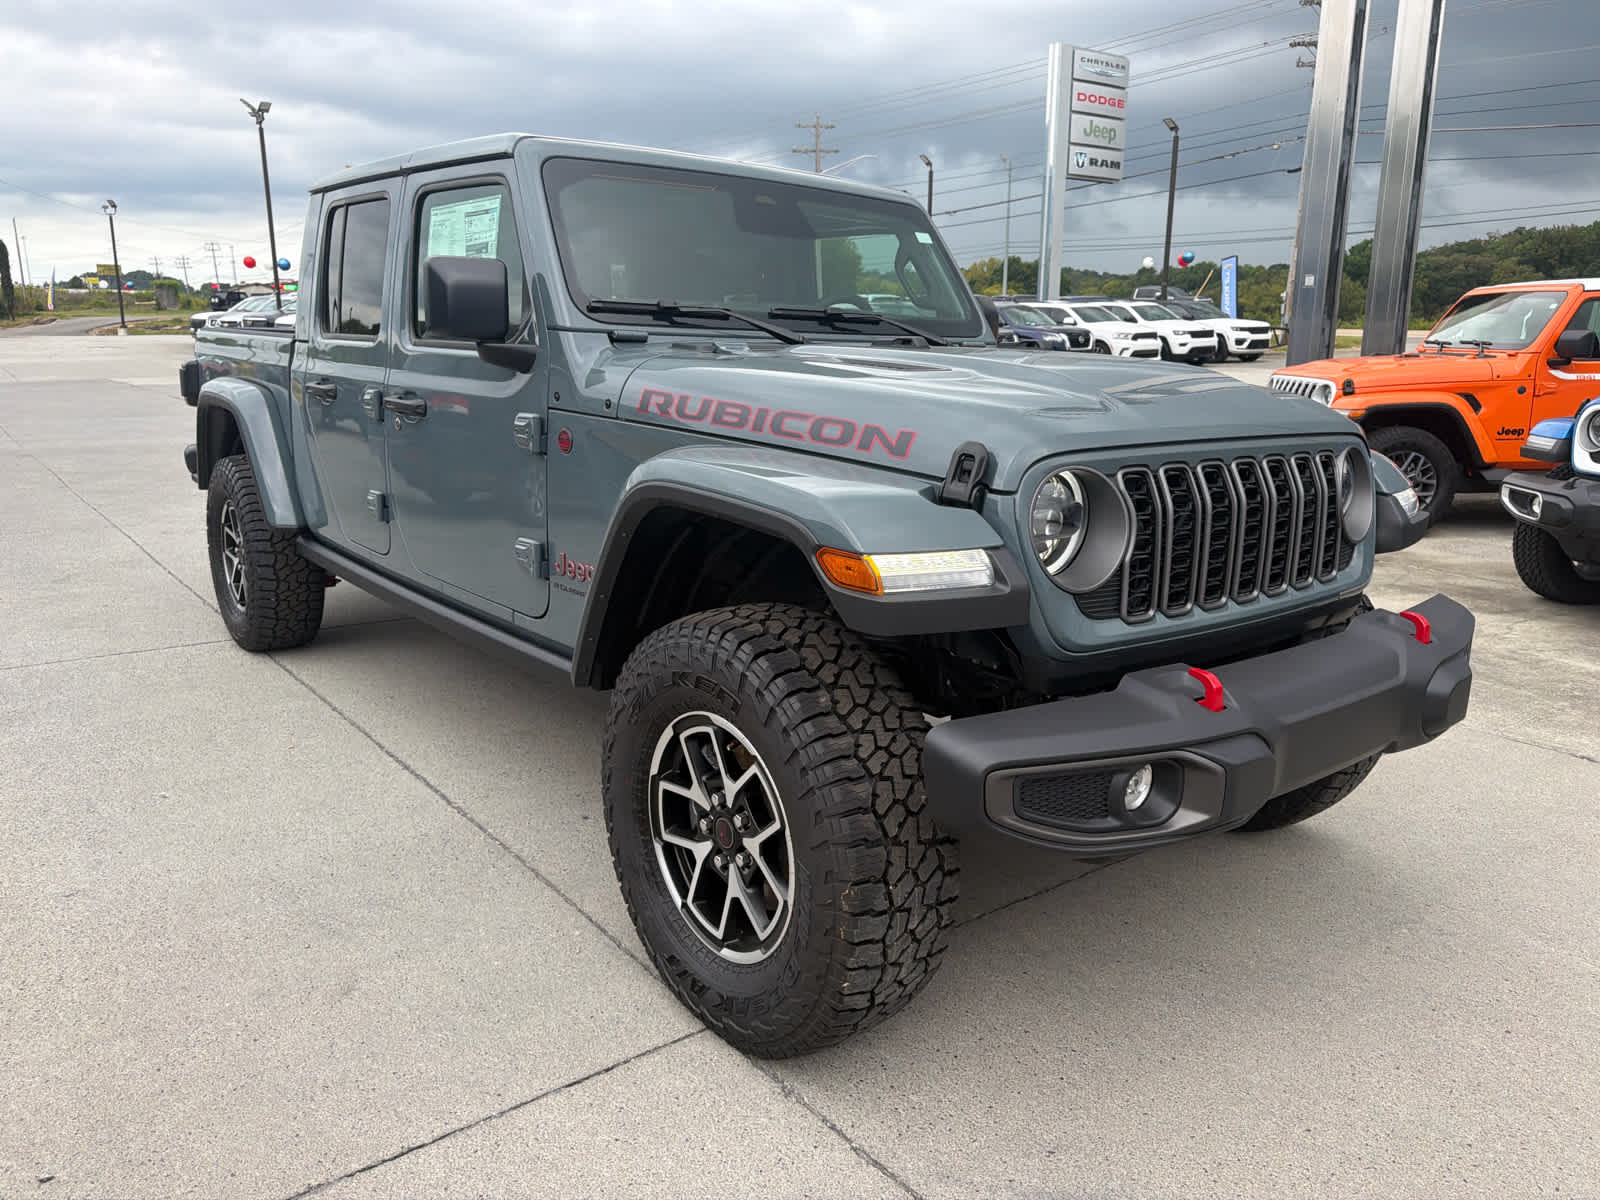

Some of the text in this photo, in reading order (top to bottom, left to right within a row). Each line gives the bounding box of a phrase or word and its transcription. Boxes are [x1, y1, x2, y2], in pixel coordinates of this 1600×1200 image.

[1080, 57, 1126, 70] CHRYSLER
[1076, 92, 1125, 109] DODGE
[1083, 119, 1117, 144] Jeep
[1089, 157, 1121, 170] RAM
[637, 388, 918, 460] RUBICON
[1497, 426, 1525, 437] Jeep
